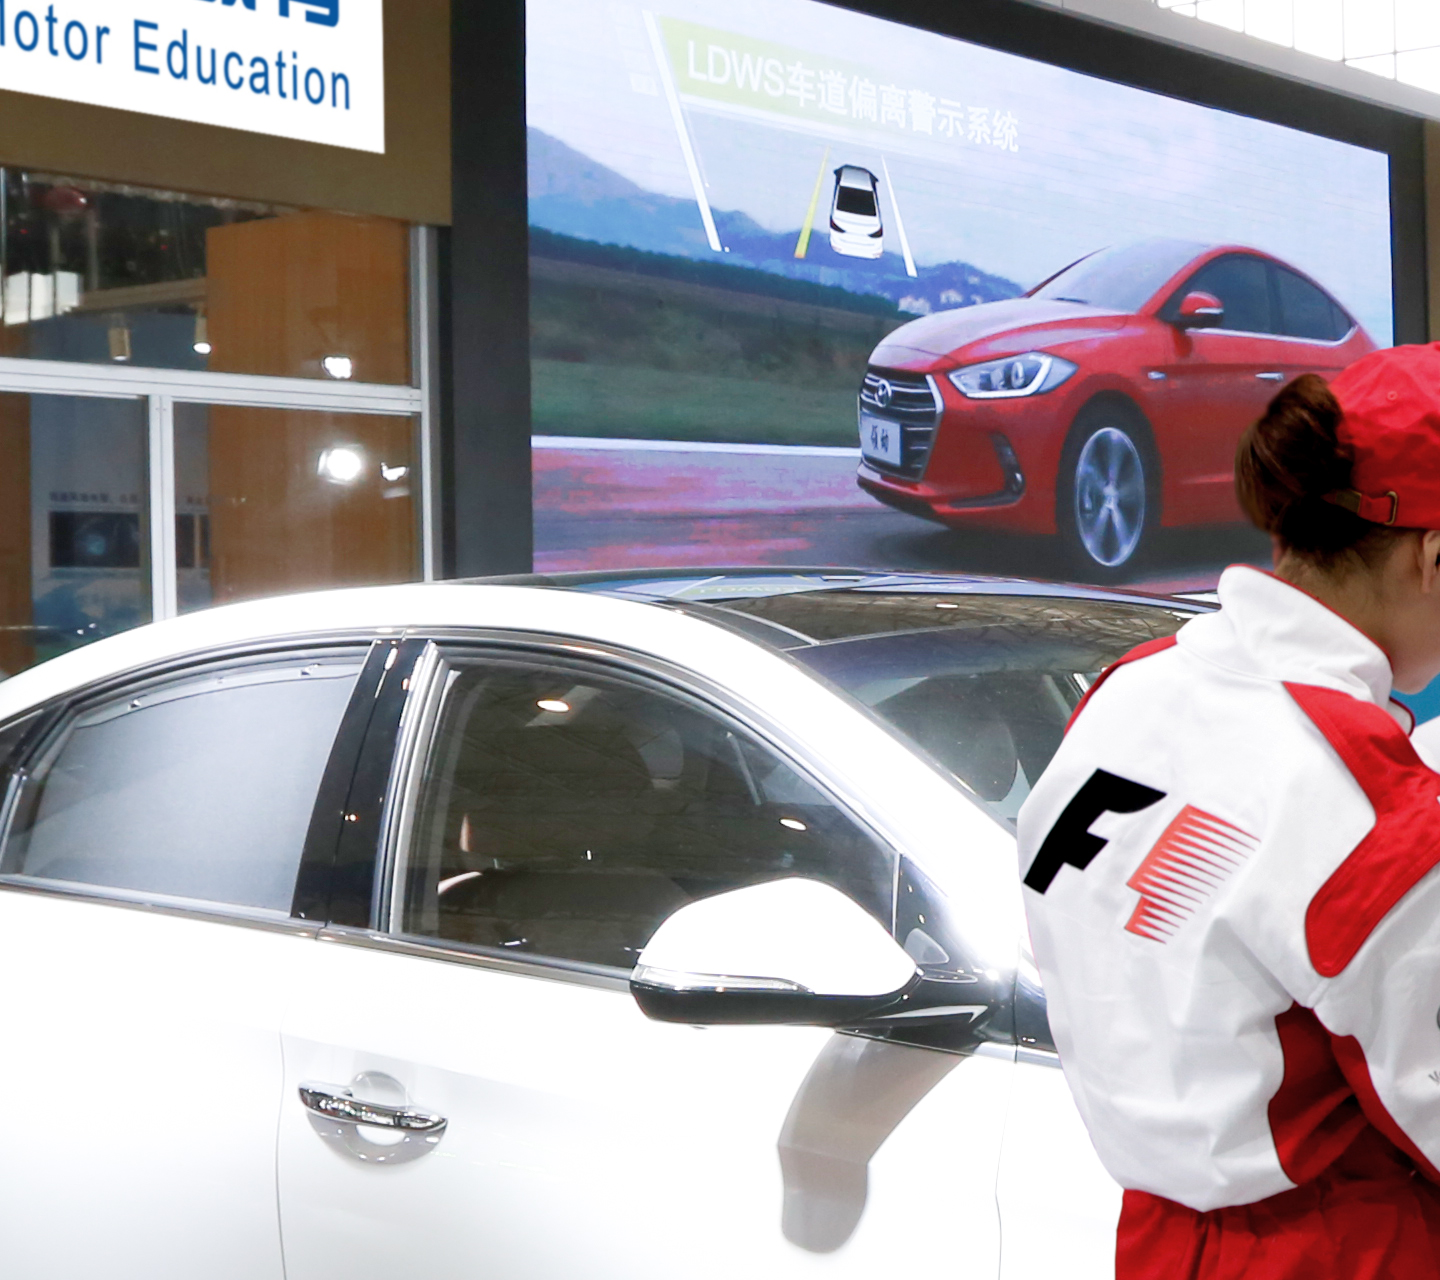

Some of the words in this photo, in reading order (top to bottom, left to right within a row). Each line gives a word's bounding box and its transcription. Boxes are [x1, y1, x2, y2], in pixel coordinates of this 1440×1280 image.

[133, 18, 352, 110] Education
[686, 39, 1020, 153] LDWS车道偏离警示系统
